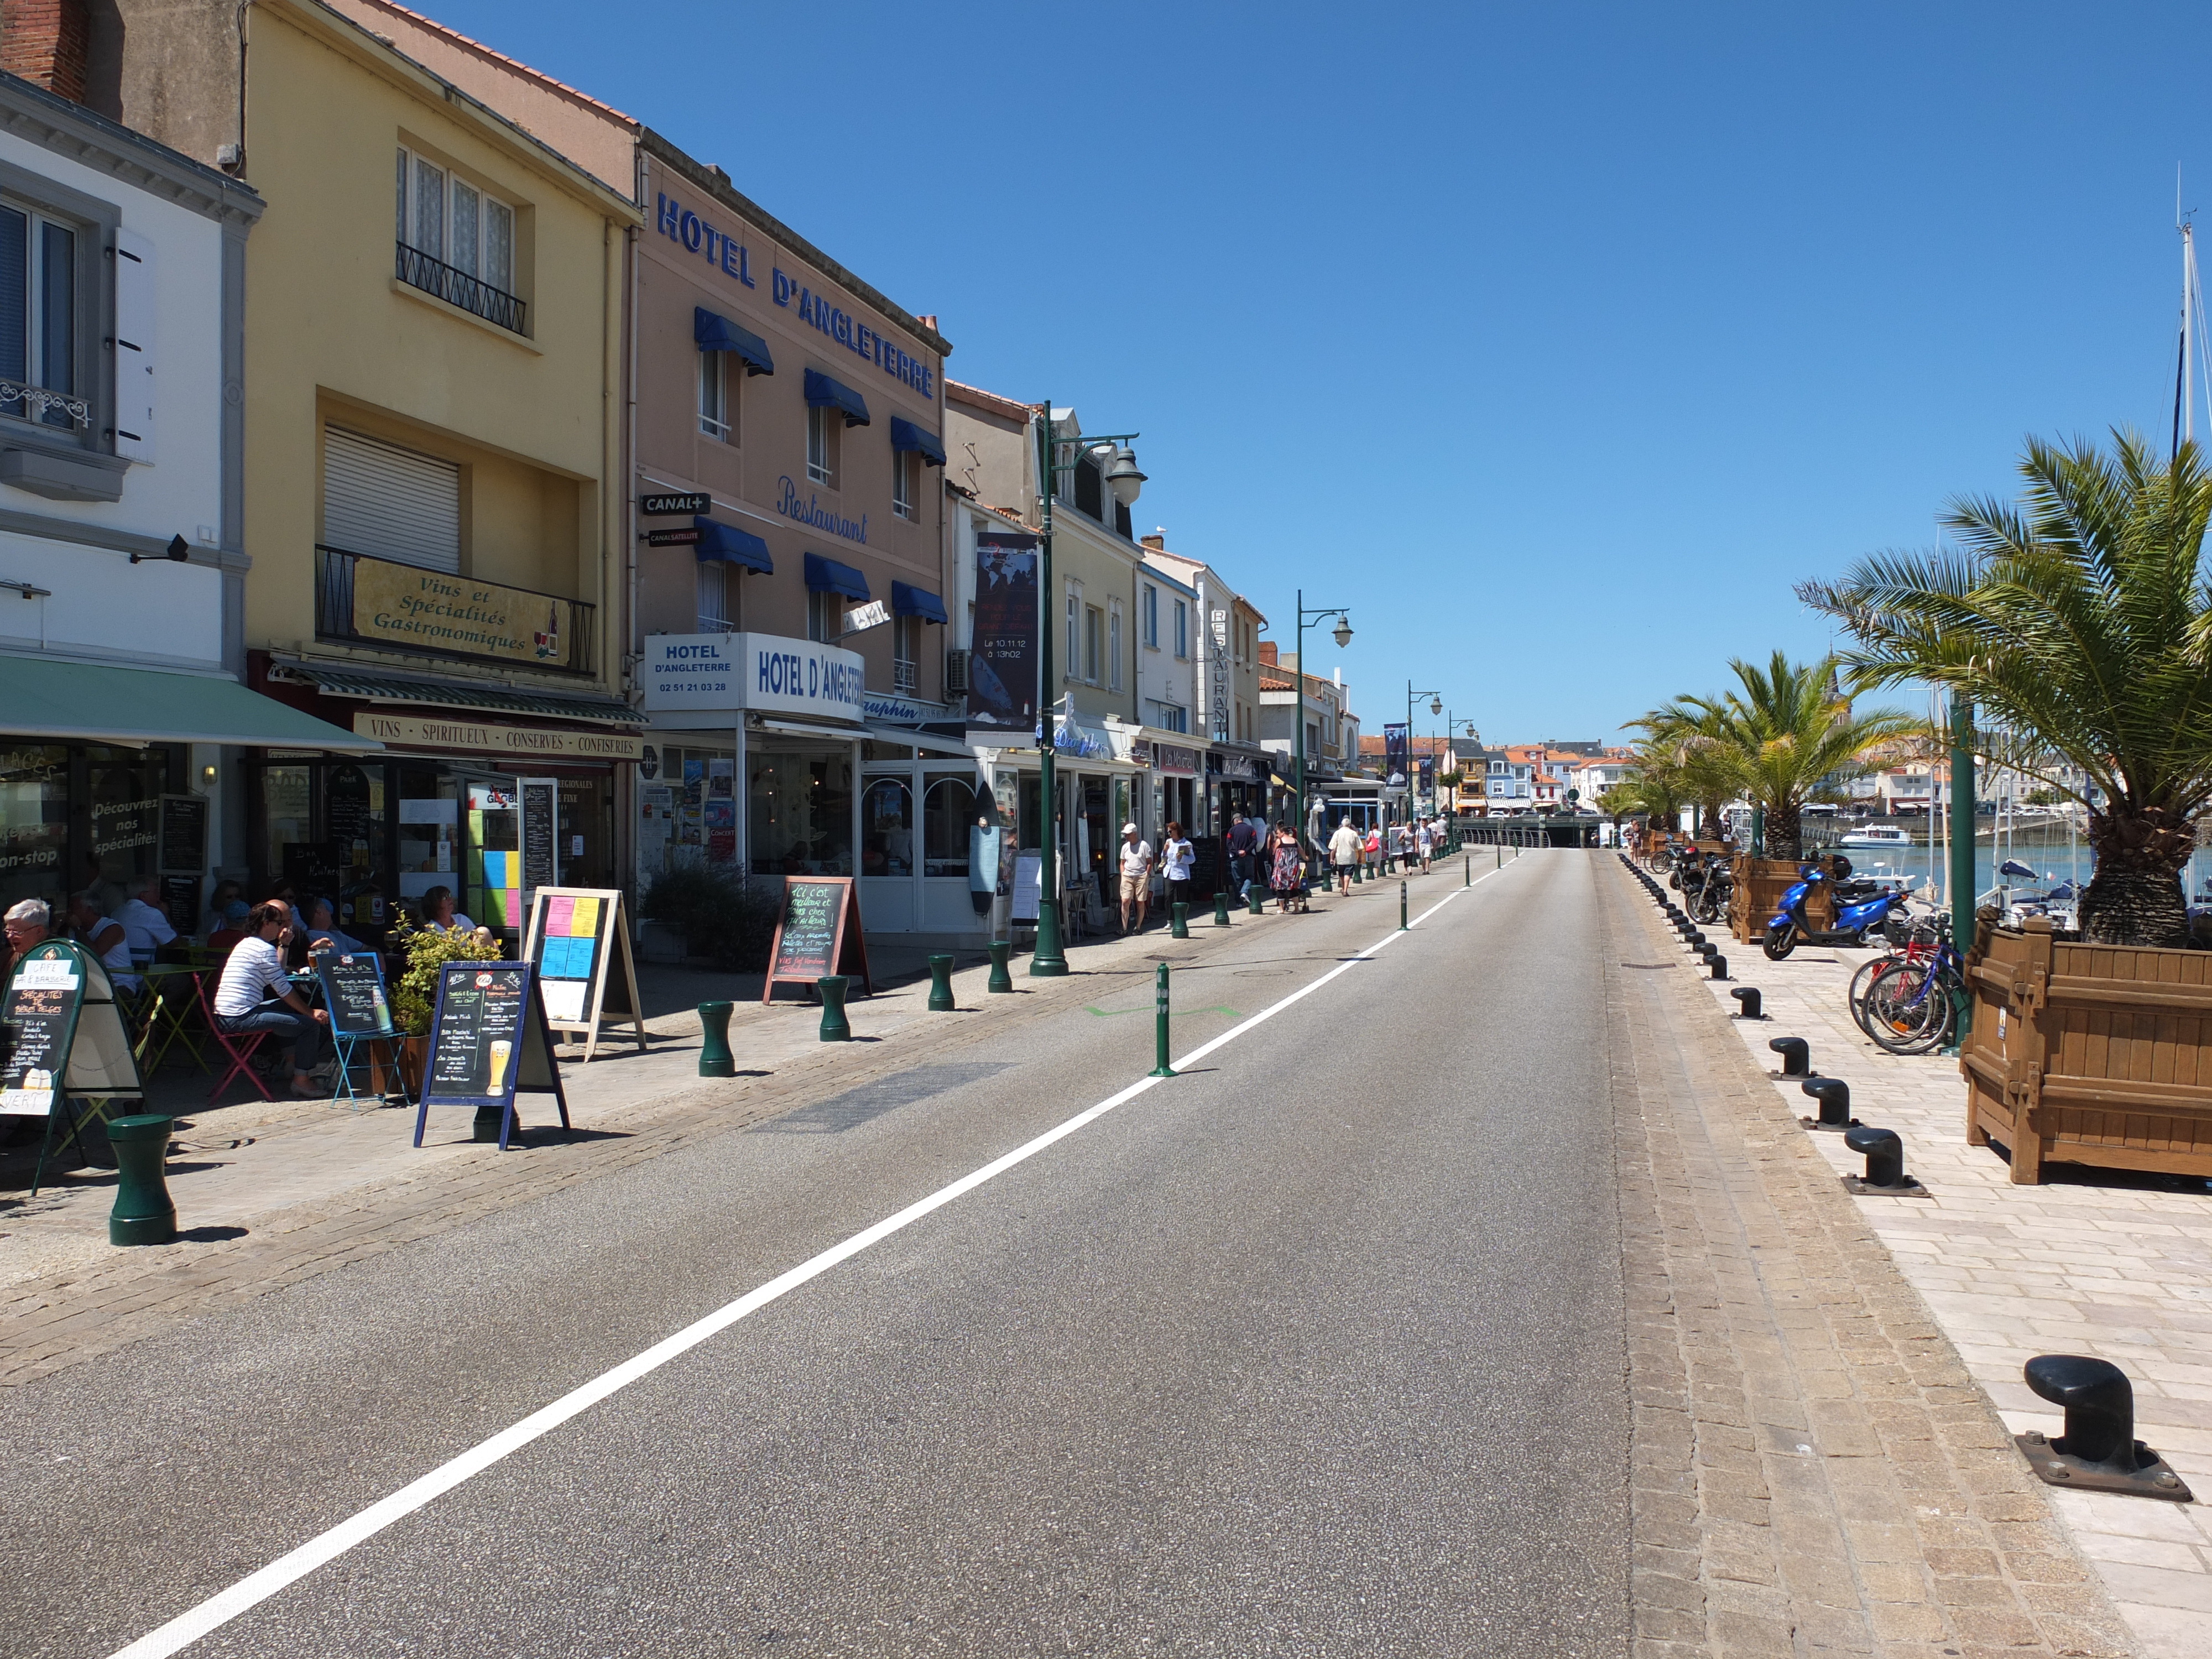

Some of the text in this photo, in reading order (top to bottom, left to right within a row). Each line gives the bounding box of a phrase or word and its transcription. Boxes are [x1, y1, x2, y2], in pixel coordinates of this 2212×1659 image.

[658, 191, 935, 400] HOTEL D'ANGLETERRE
[646, 496, 703, 510] CANAL+
[777, 476, 868, 544] Restaurant
[650, 532, 698, 541] CANALSATELLITE
[421, 577, 490, 603] Vins et
[399, 594, 506, 626] Spécialités
[374, 612, 526, 652] Gastronomiques
[667, 645, 719, 659] HOTEL
[984, 639, 1026, 648] Le 10.11.12
[655, 663, 731, 672] D'ANGLETERRE
[759, 651, 804, 697] HOTEL
[1213, 611, 1224, 732] RESTAURANT
[701, 683, 712, 691] 03
[372, 719, 634, 754] VINS SPIRITUEUX CONSERVES CONFISERIES
[645, 756, 653, 769] H
[564, 794, 578, 802] FINE
[94, 799, 159, 817] Découvrez
[116, 818, 138, 832] nos
[95, 831, 157, 856] spécialités
[0, 849, 57, 868] on-stop
[822, 898, 832, 907] et
